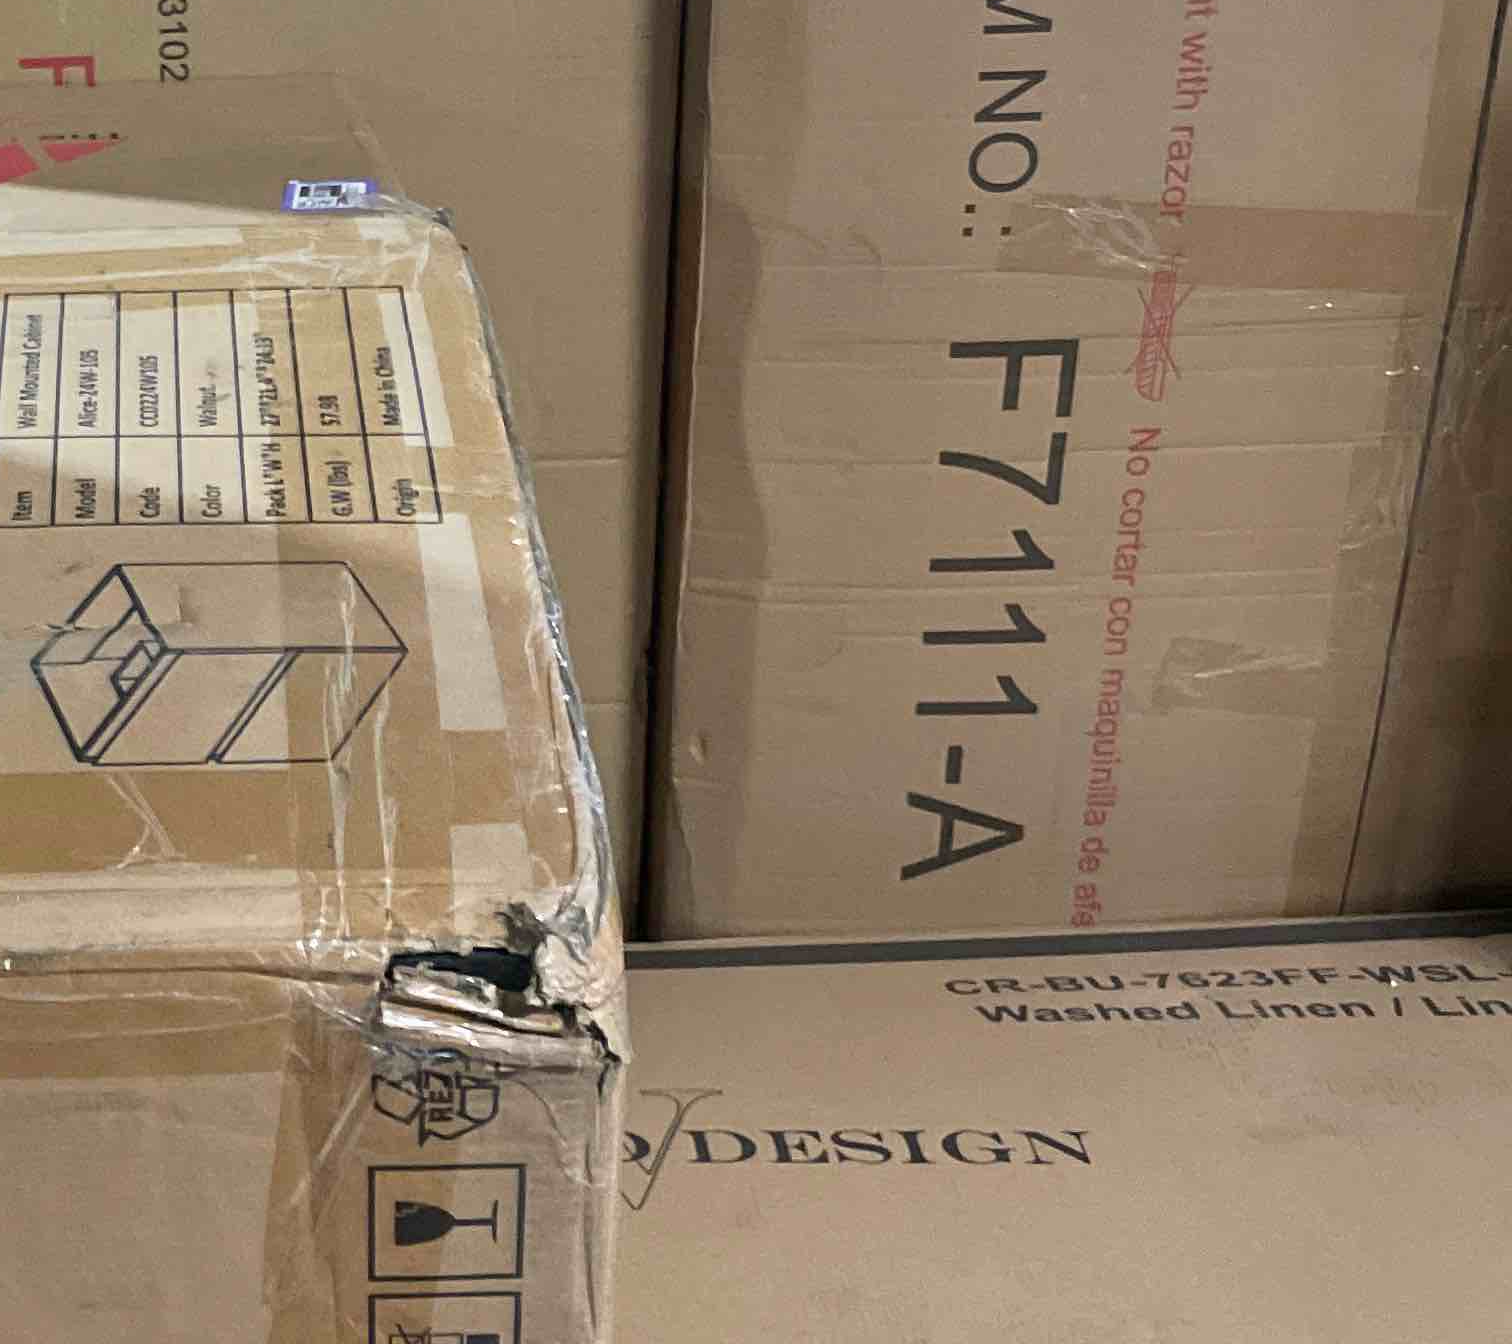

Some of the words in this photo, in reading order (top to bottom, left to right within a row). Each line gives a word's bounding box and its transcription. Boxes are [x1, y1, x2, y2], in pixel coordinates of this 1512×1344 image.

[1173, 30, 1213, 110] with
[962, 69, 1048, 237] NO.:
[1159, 125, 1195, 223] razor
[19, 351, 42, 404] Mounted
[376, 345, 397, 378] China
[17, 404, 39, 430] Wall
[383, 393, 403, 426] Made
[1126, 425, 1162, 478] No
[11, 491, 33, 522] Item
[75, 478, 97, 520] Model
[140, 486, 162, 519] Code
[201, 484, 224, 519] Color
[266, 488, 288, 520] Pack
[394, 478, 421, 518] Origin
[1111, 487, 1147, 588] cortar
[899, 337, 1080, 880] F7111-A
[1103, 595, 1134, 657] con
[1083, 667, 1126, 828] maquinilla
[1077, 834, 1110, 874] de
[975, 1000, 1202, 1024] Washed
[1213, 997, 1377, 1021] Linen
